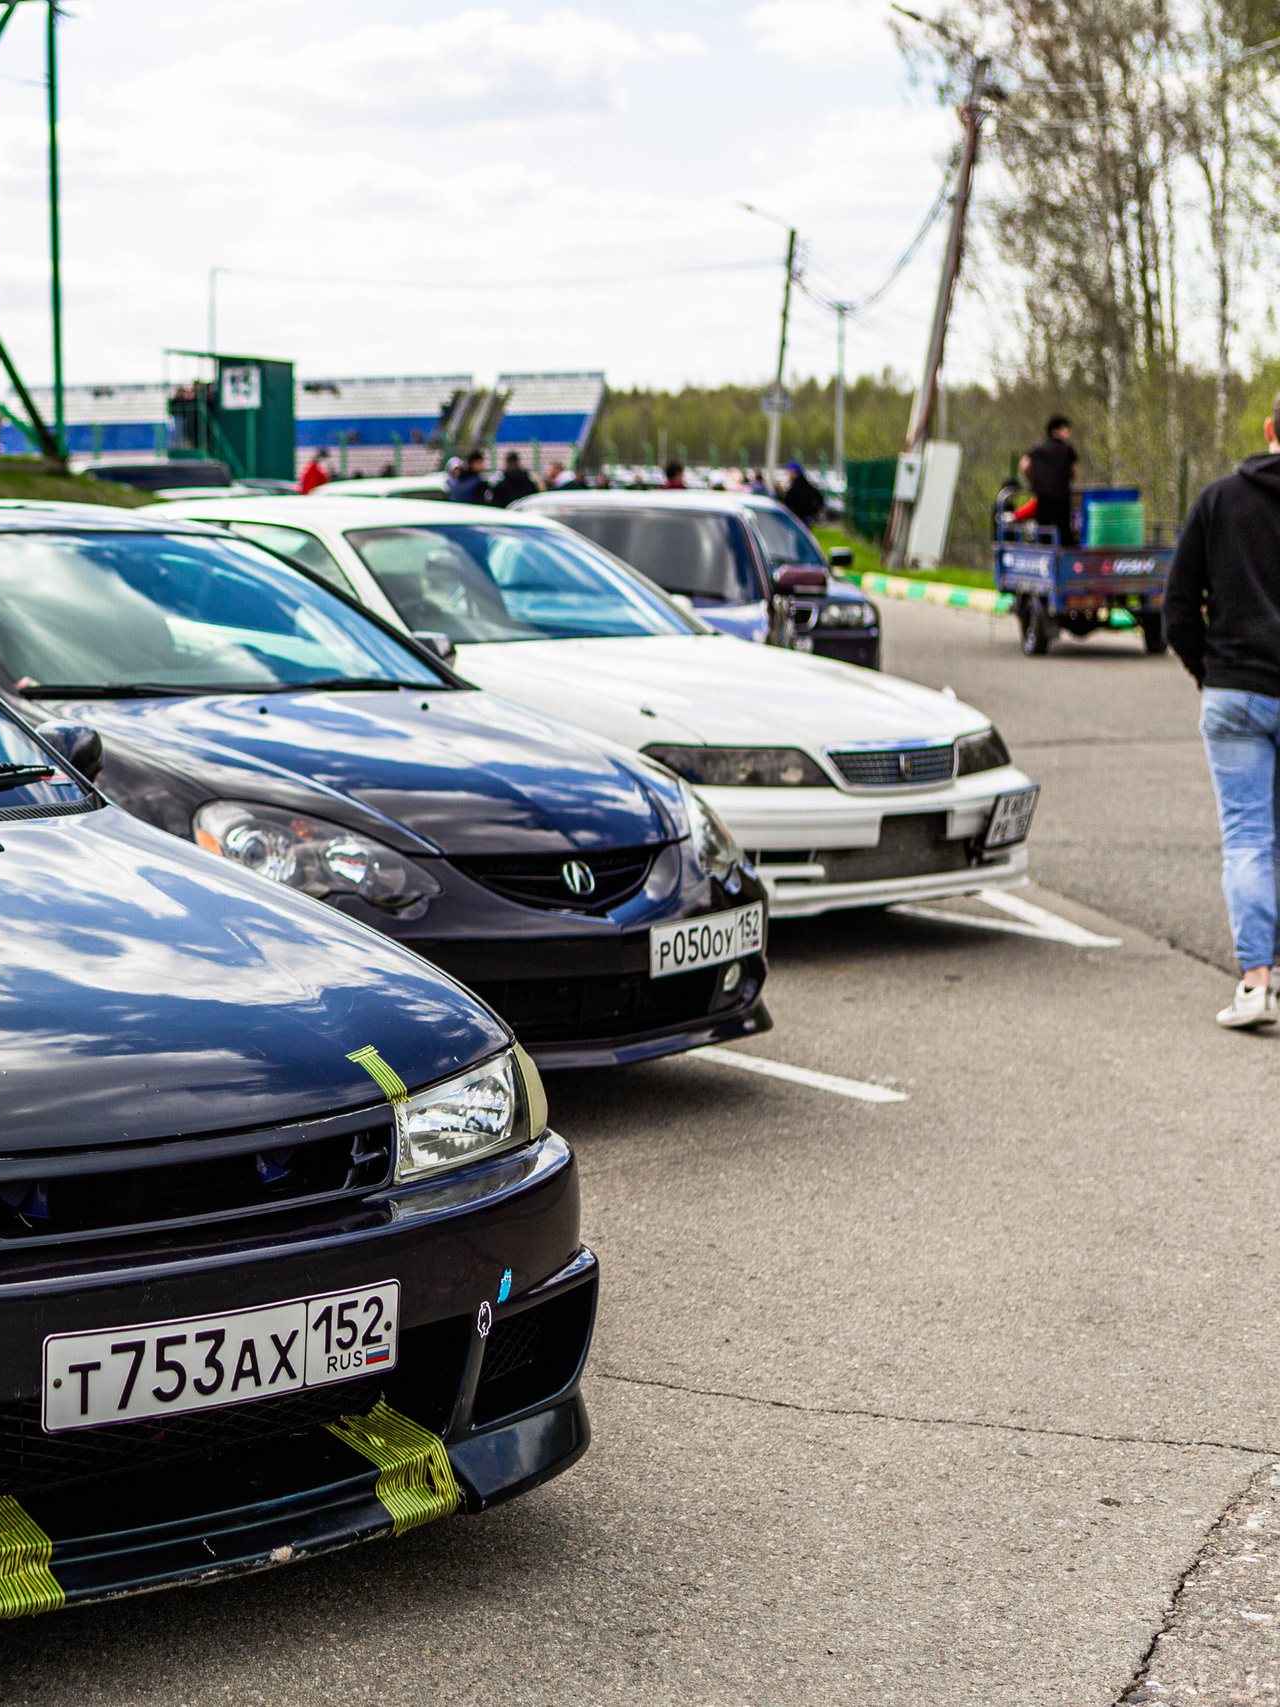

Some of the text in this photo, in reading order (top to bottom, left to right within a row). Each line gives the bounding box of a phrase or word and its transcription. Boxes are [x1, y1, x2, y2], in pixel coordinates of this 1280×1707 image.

[738, 909, 760, 940] 152
[311, 1295, 384, 1355] 152
[326, 1350, 363, 1374] RUS
